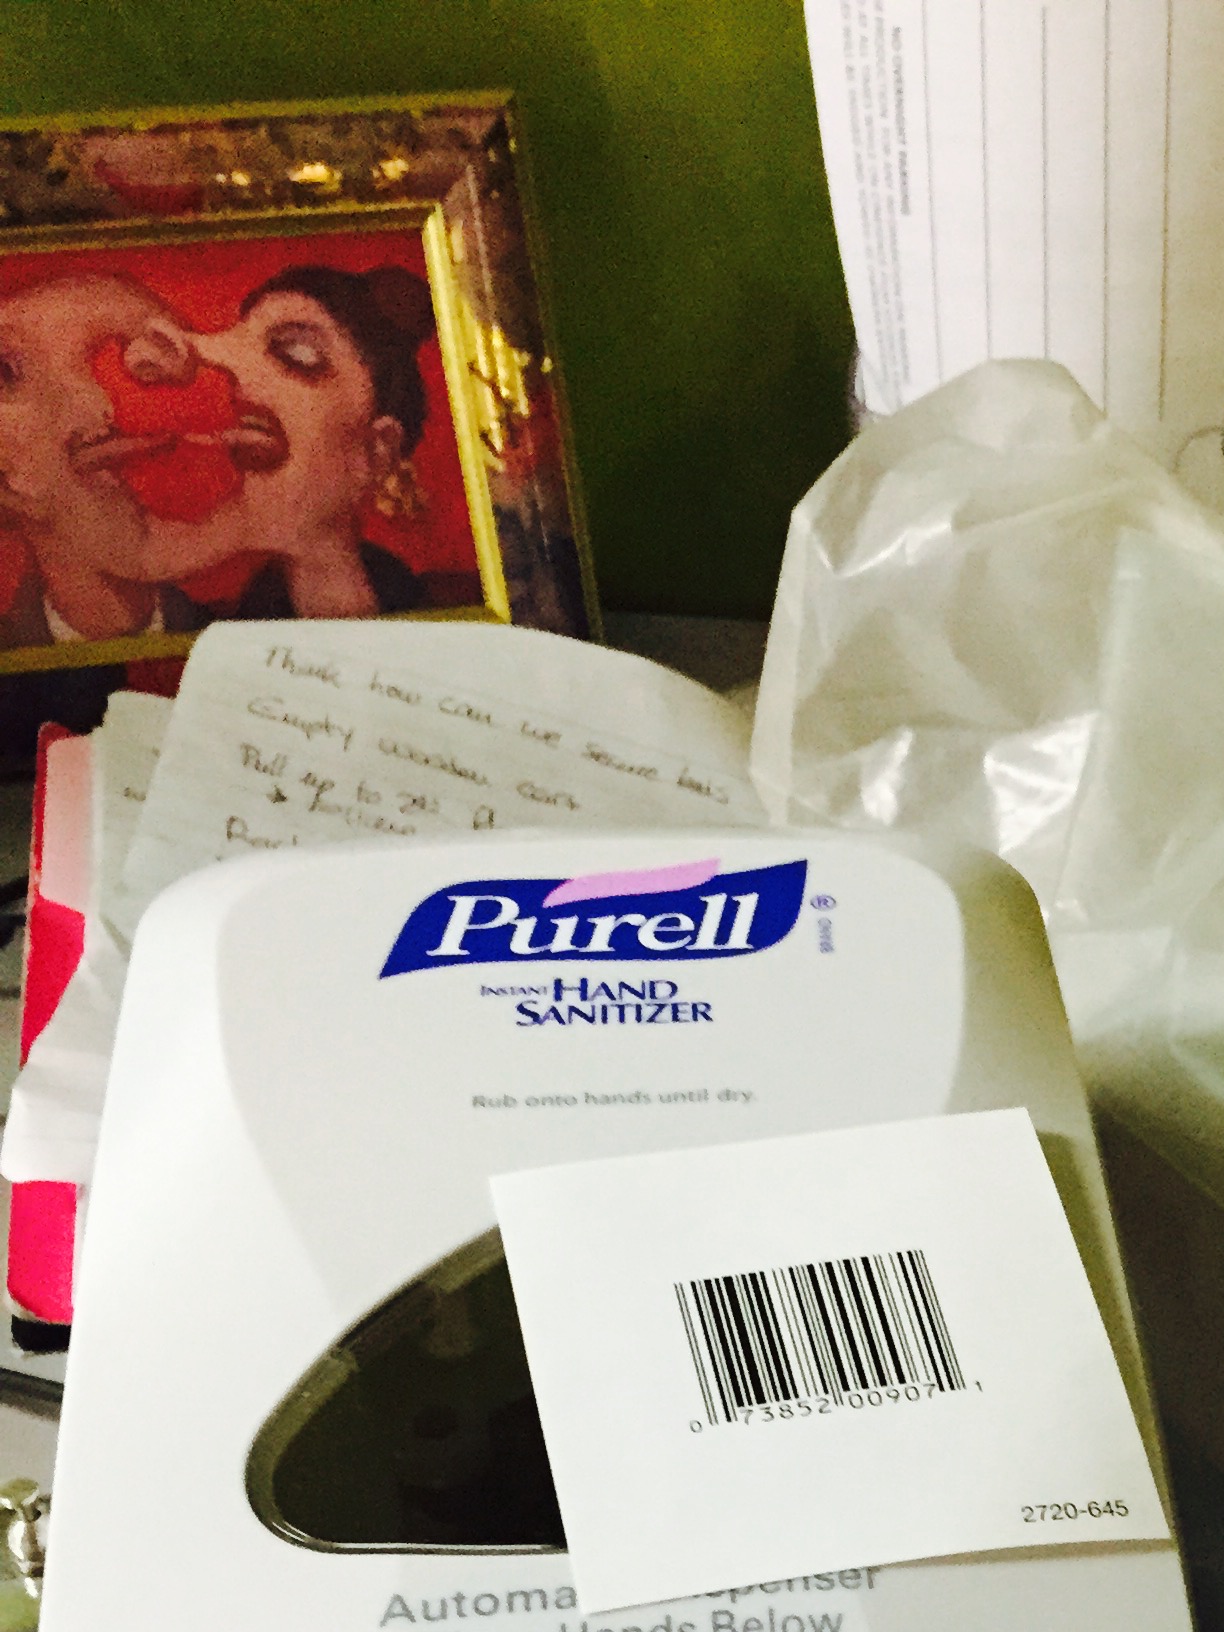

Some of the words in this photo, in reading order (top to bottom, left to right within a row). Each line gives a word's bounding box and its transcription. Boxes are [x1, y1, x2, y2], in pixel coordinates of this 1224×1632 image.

[426, 892, 760, 956] Purell
[552, 977, 679, 1002] HAND
[515, 1000, 714, 1027] SANITIZER
[471, 1094, 518, 1108] Rub
[524, 1094, 578, 1107] onto
[584, 1090, 651, 1107] hands
[657, 1088, 710, 1105] until
[740, 1396, 833, 1427] 73852
[849, 1382, 937, 1410] 00907
[1020, 1499, 1130, 1525] 2720-645
[380, 1586, 577, 1627] Automa
